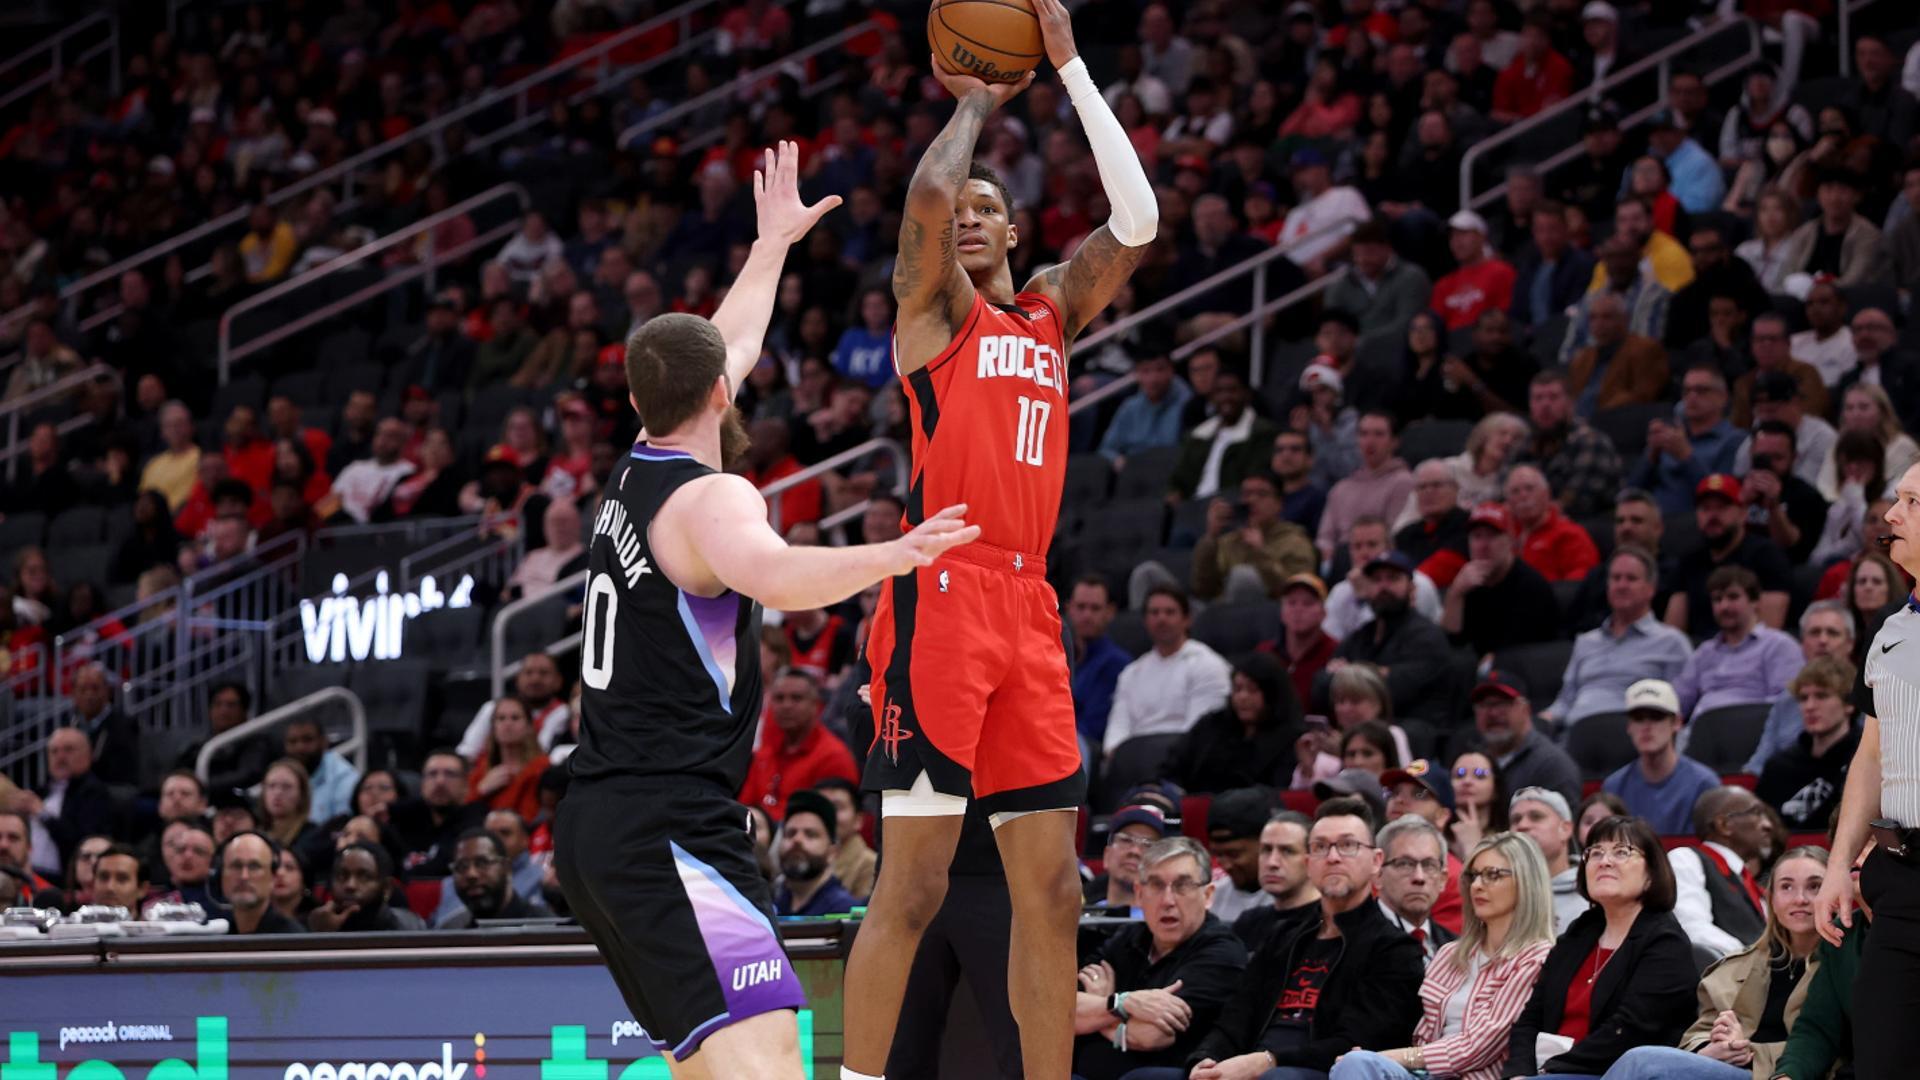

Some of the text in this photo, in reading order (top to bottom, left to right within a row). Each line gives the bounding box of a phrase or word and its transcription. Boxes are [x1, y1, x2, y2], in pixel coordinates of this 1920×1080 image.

[952, 42, 1025, 80] Wilson
[1015, 395, 1051, 467] 10
[732, 958, 782, 991] UTAH
[60, 1020, 173, 1051] peacock ORIGINAL
